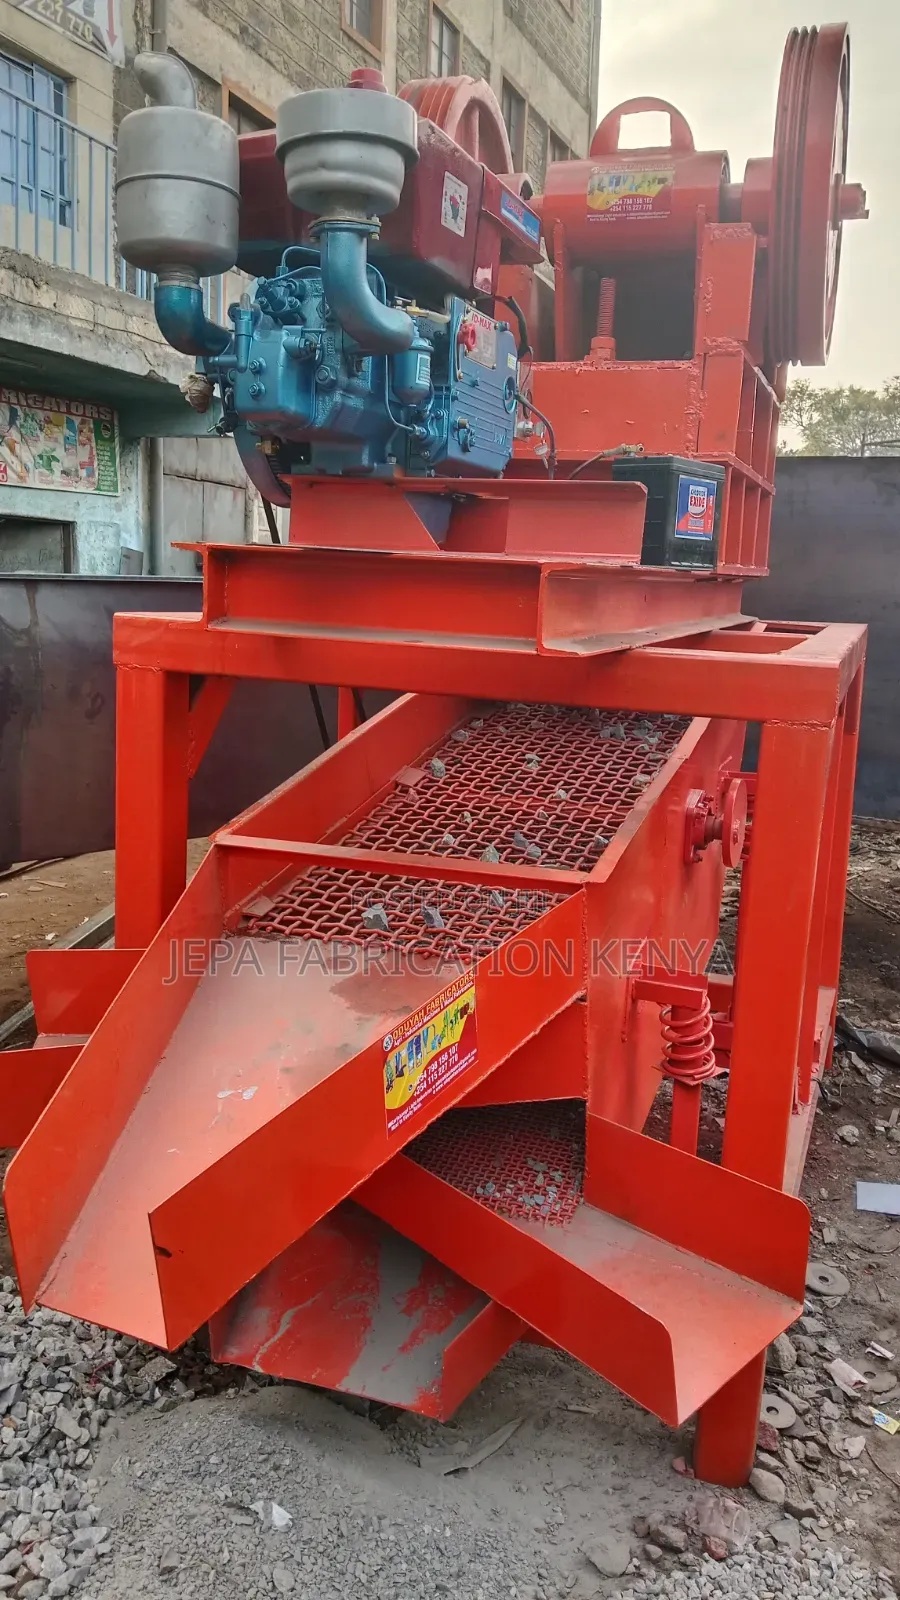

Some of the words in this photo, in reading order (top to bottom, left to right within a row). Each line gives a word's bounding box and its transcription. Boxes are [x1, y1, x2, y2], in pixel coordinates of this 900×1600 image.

[67, 12, 93, 42] 770
[690, 495, 705, 508] EXIDE
[393, 1010, 424, 1040] ODUYAH
[426, 967, 474, 1013] FABRICATORS
[428, 1071, 438, 1084] 115
[438, 1062, 448, 1076] 227
